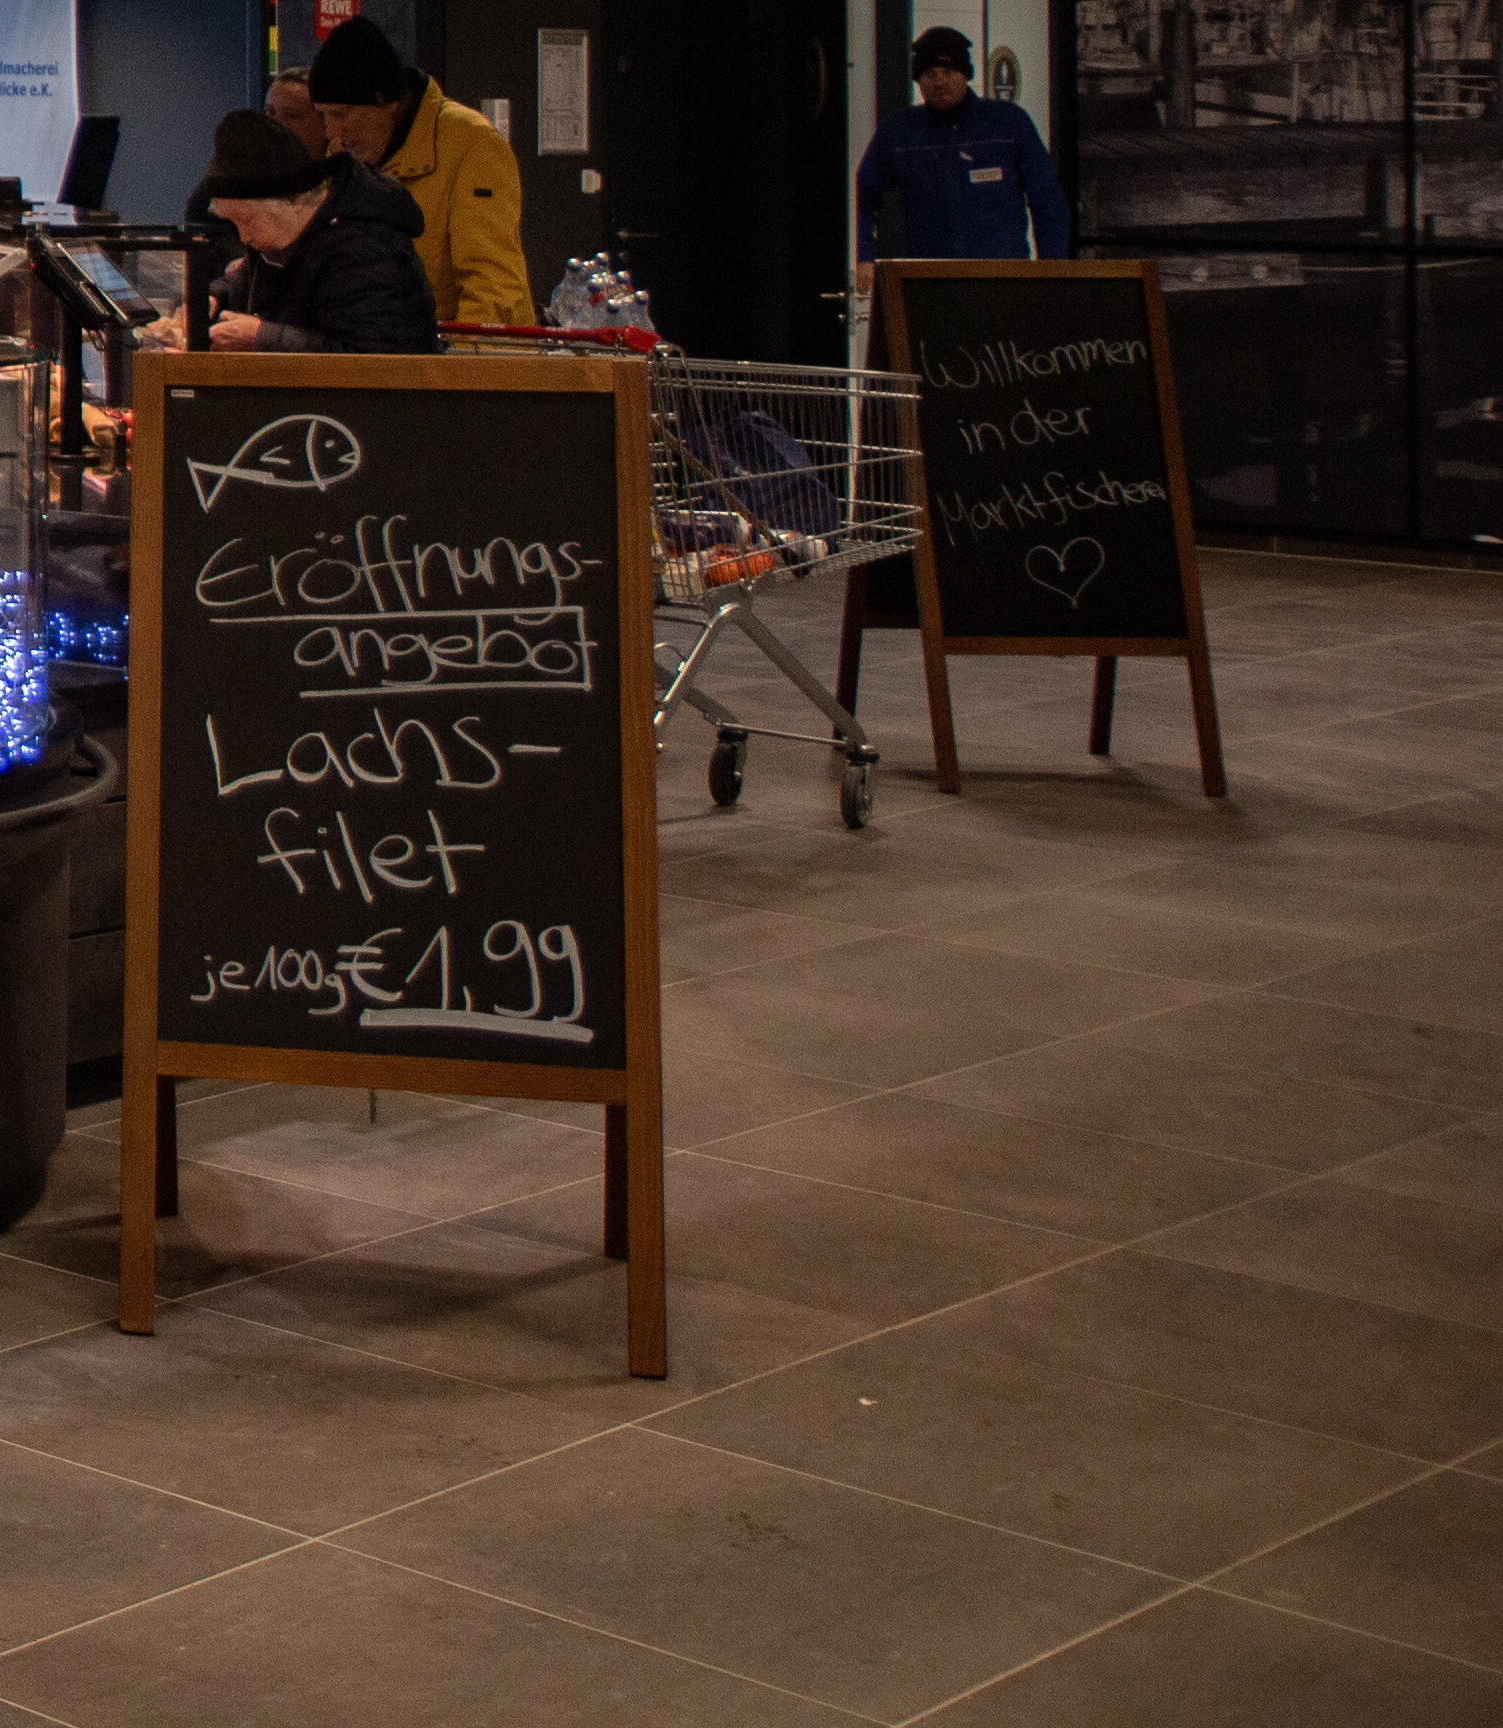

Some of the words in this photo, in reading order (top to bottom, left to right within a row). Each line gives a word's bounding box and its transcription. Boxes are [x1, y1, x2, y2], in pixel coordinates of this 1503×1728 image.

[30, 82, 52, 97] e.K.
[920, 338, 1147, 389] Willkommen
[957, 418, 1006, 455] in
[1010, 398, 1092, 446] der
[195, 514, 603, 625] Eröffnungs-
[294, 613, 599, 687] angebot
[206, 707, 562, 796] Lachs-
[257, 807, 486, 904] filet
